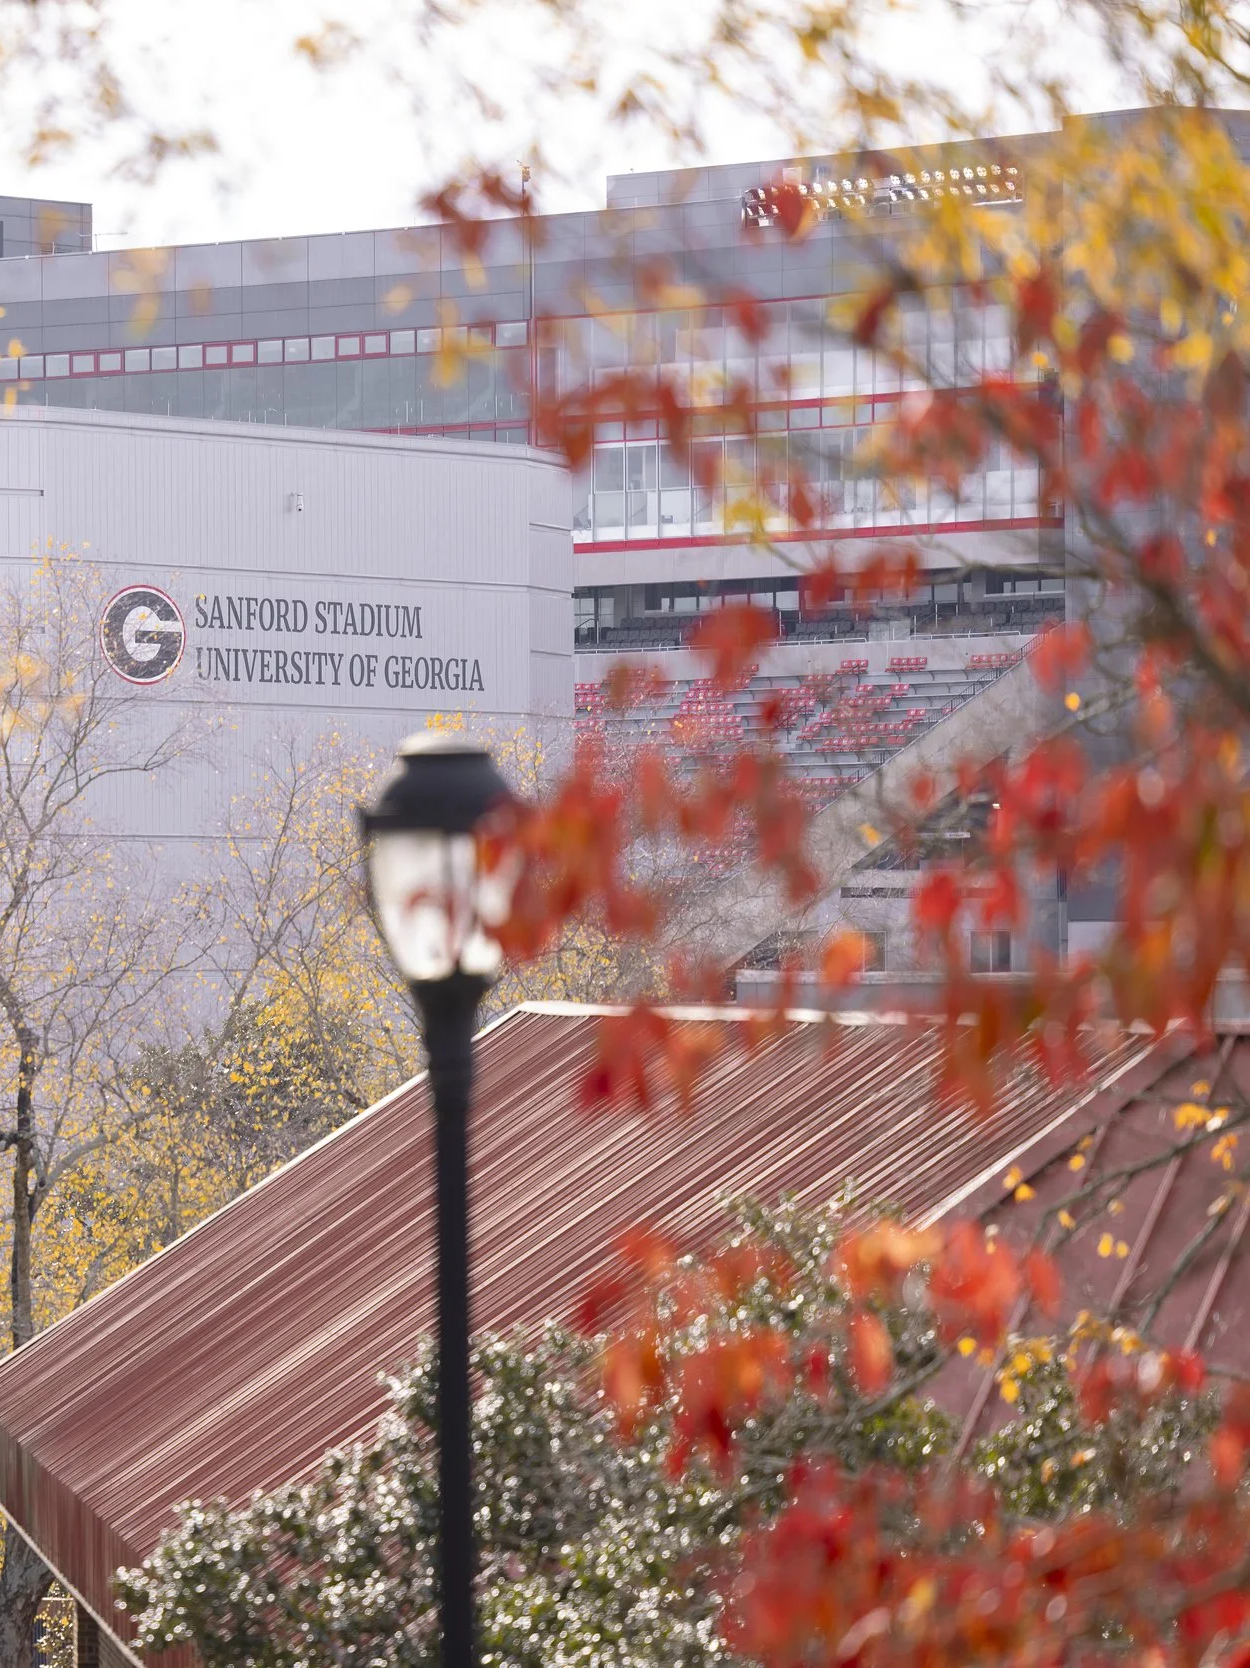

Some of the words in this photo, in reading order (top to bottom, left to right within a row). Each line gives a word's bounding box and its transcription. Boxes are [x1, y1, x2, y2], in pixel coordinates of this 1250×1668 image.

[103, 589, 184, 680] G
[195, 594, 308, 632] SANFORD
[315, 600, 423, 638] STADIUM
[196, 647, 343, 685] UNIVERSITY
[349, 653, 377, 686] OF
[384, 657, 484, 691] GEORGIA
